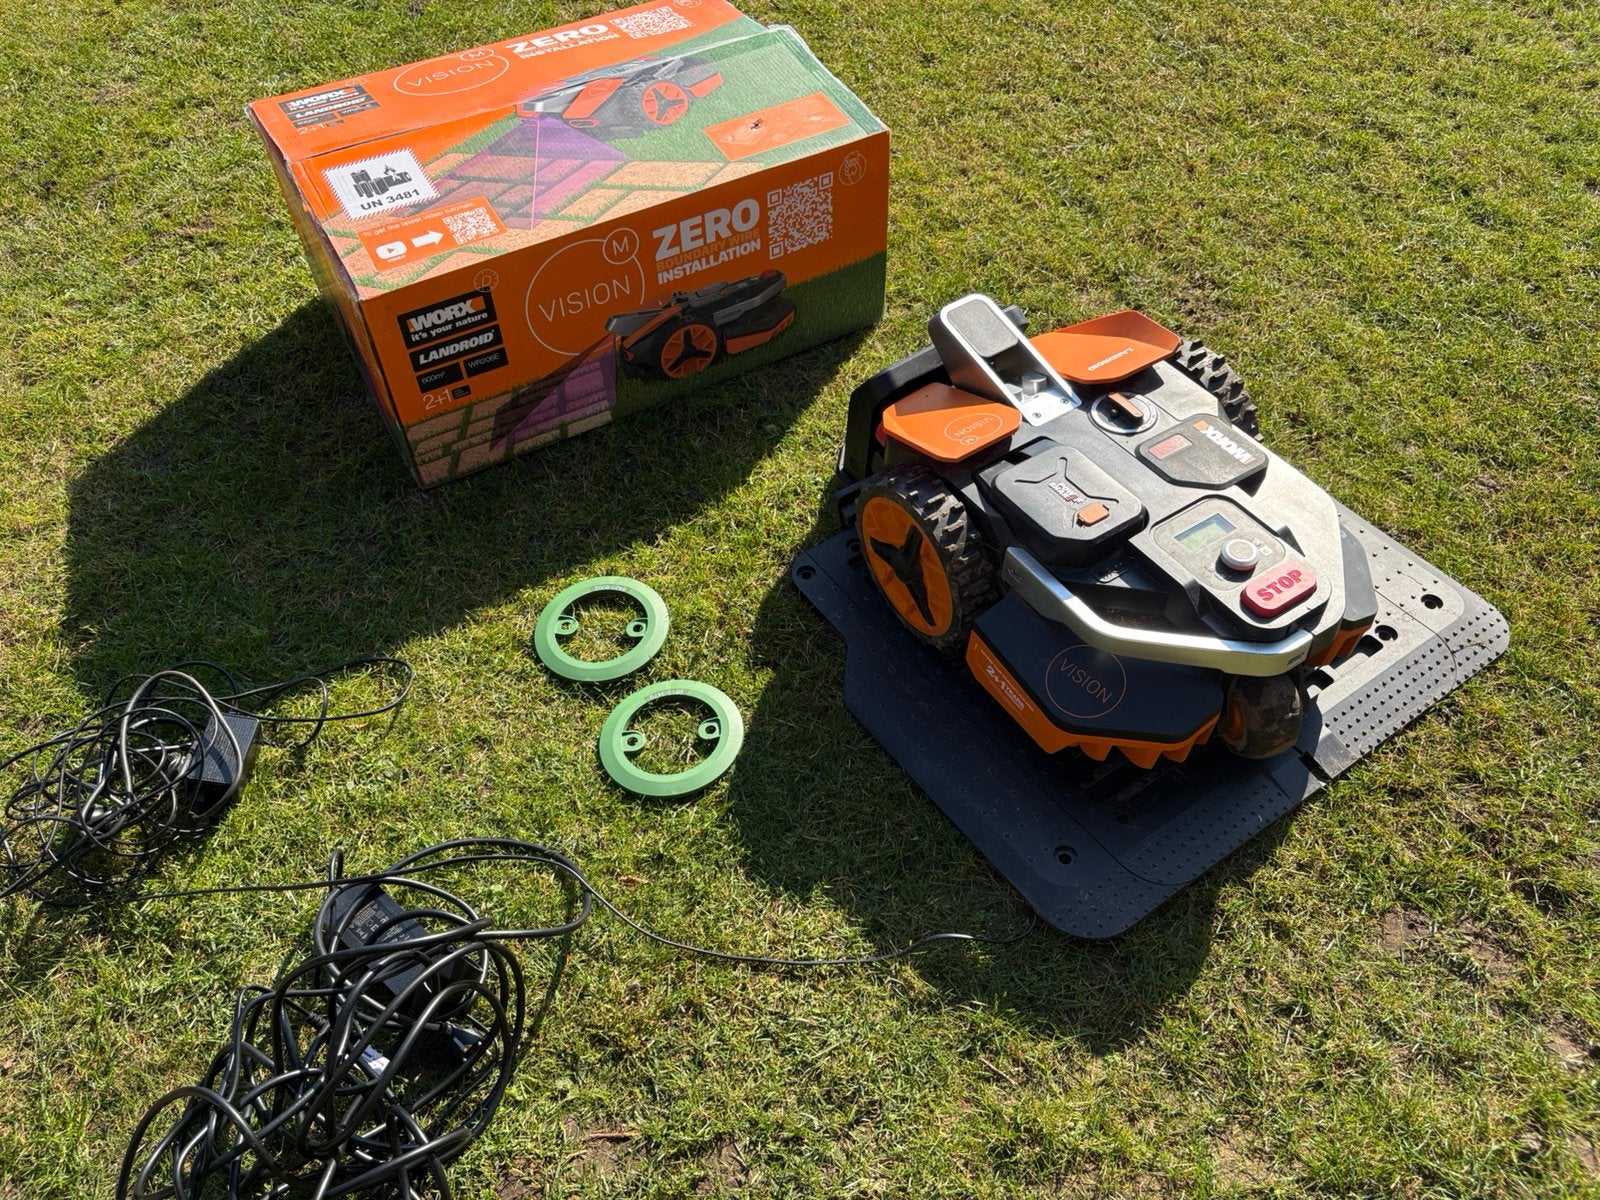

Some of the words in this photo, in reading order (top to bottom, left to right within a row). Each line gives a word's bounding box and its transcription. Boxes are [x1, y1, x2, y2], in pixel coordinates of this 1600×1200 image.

[506, 24, 608, 53] ZERO
[468, 51, 485, 59] M
[406, 60, 495, 87] VISION
[360, 199, 383, 211] UN
[386, 189, 421, 204] 3481
[387, 223, 400, 231] the
[401, 217, 422, 226] latest
[424, 211, 443, 220] video
[652, 198, 760, 262] ZERO
[612, 236, 630, 256] M
[656, 238, 726, 273] BOUNDARY
[729, 228, 760, 247] WIRE
[657, 238, 761, 286] INSTALLATION
[538, 274, 631, 323] VISION
[409, 299, 477, 333] WORX
[411, 331, 428, 342] it's
[430, 323, 453, 338] your
[455, 312, 488, 327] nature
[422, 389, 452, 410] 2+1
[954, 416, 993, 437] VISION
[1201, 423, 1253, 464] WORX
[1257, 570, 1303, 602] STOP
[986, 665, 1006, 690] 2+1
[1060, 657, 1113, 704] VISION
